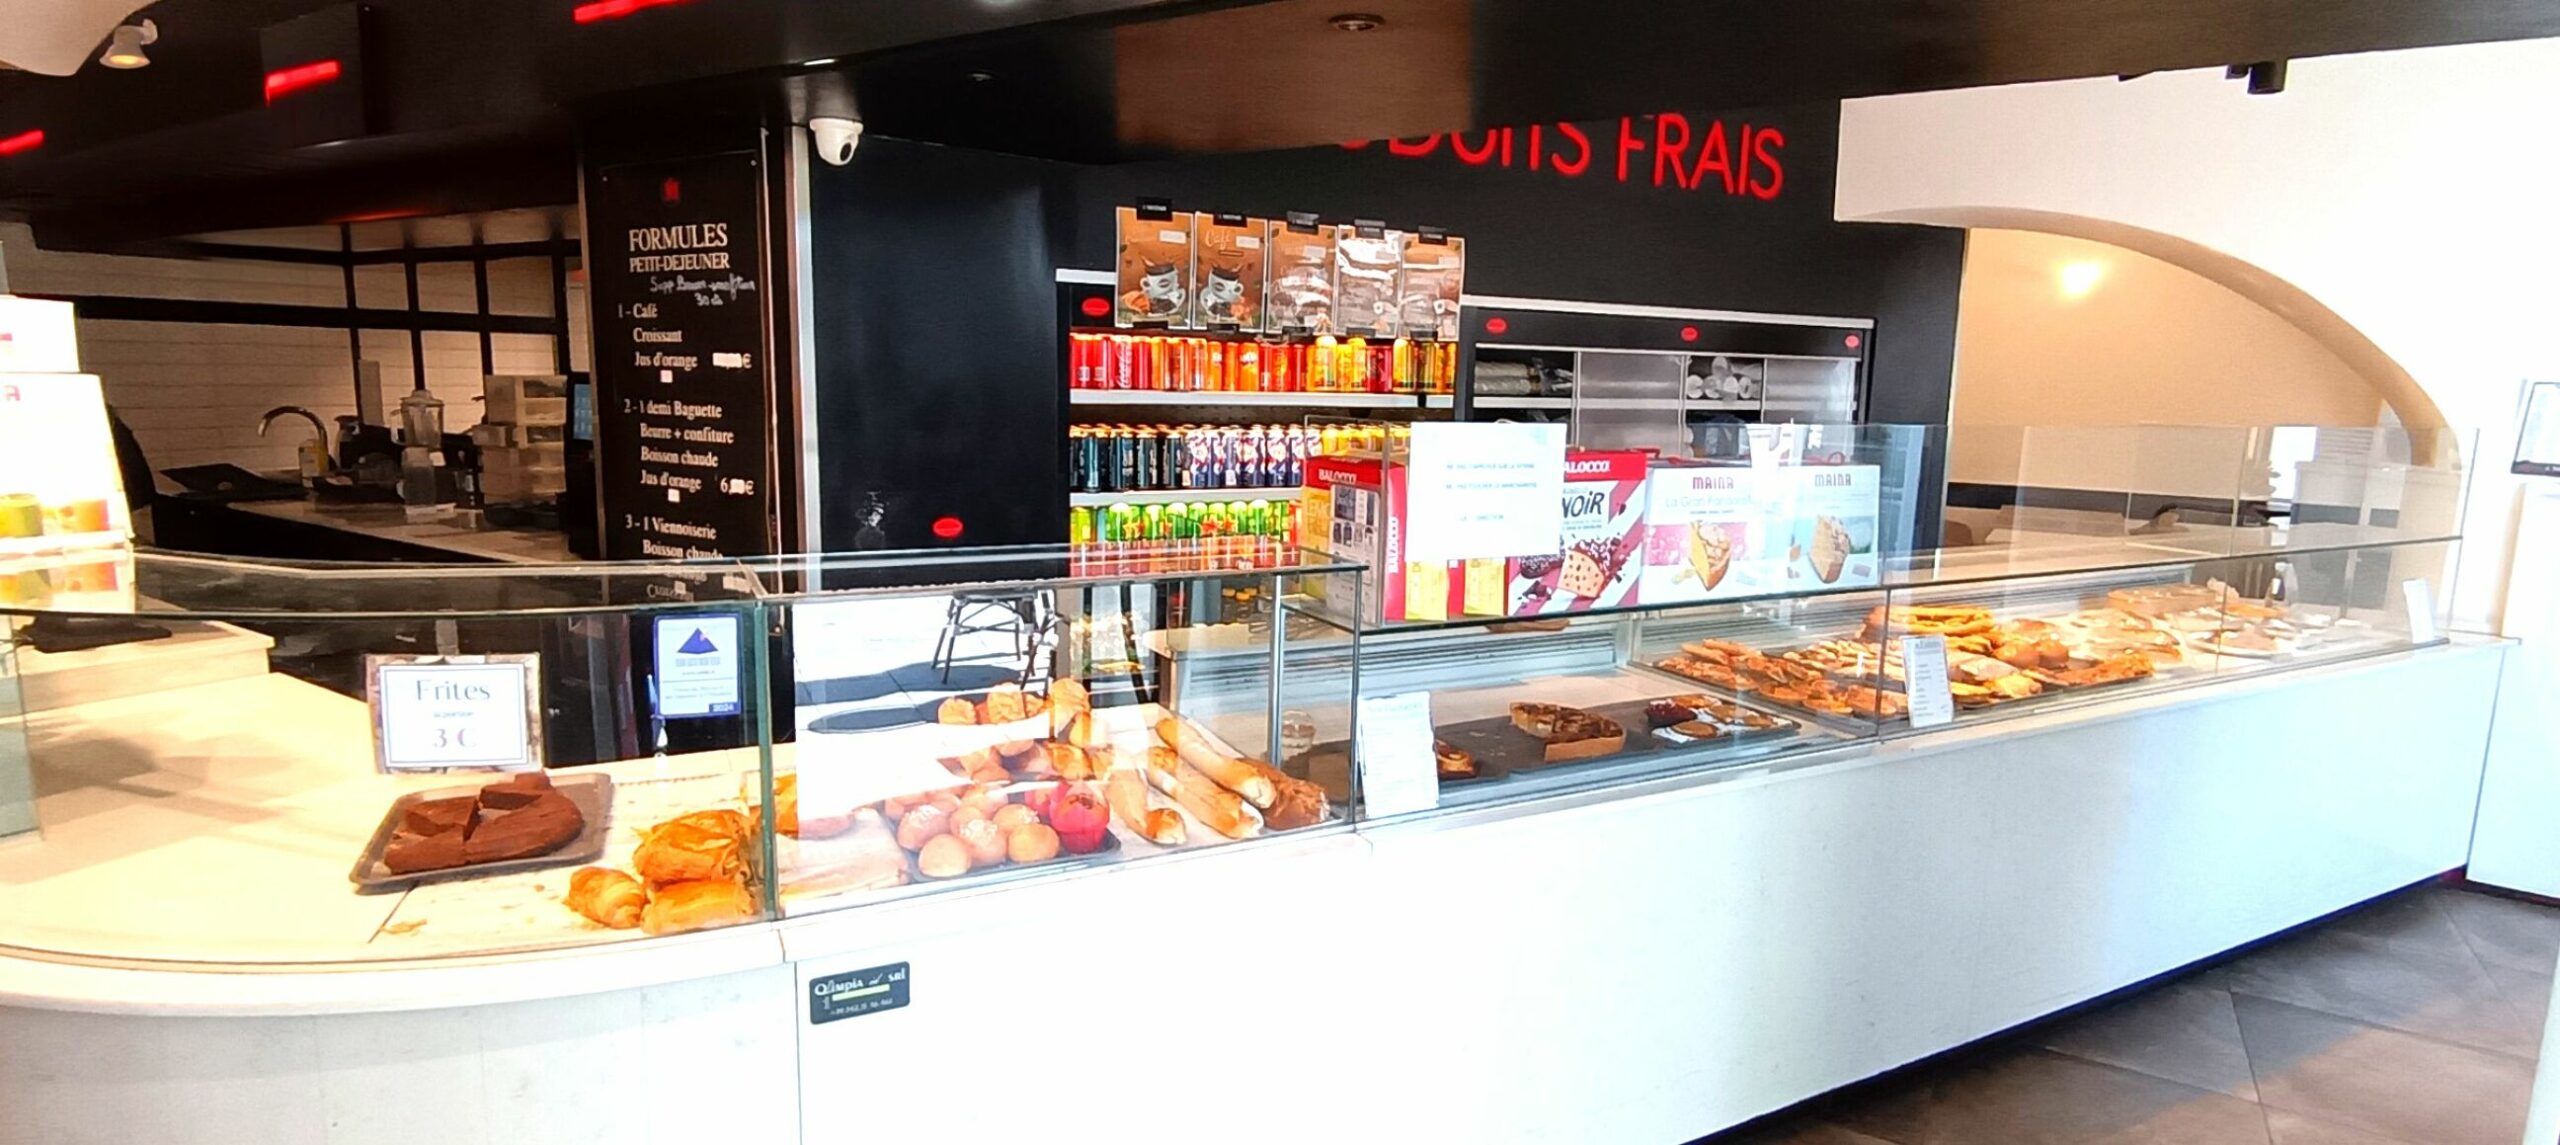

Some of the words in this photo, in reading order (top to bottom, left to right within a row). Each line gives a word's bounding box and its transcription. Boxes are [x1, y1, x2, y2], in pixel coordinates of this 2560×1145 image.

[1617, 111, 1785, 201] FRAIS
[629, 223, 729, 252] FORMULES
[632, 303, 659, 319] Café
[632, 327, 683, 343] Croissant
[635, 351, 651, 367] Jus
[653, 352, 699, 372] d'orange
[623, 398, 631, 414] 2
[646, 401, 672, 416] demi
[673, 400, 723, 421] Baguette
[639, 422, 672, 439] Beurre
[673, 428, 682, 439] +
[683, 427, 735, 444] confiture
[640, 446, 679, 464] Boisson
[680, 450, 719, 468] chaude
[1564, 459, 1611, 474] ALOCCO
[640, 469, 658, 485] Jus
[659, 471, 702, 494] d'orange
[625, 513, 633, 530] 3
[651, 515, 718, 541] Viennoiserie
[642, 538, 683, 559] Boisson
[416, 679, 491, 701] Frites
[432, 727, 448, 749] 3
